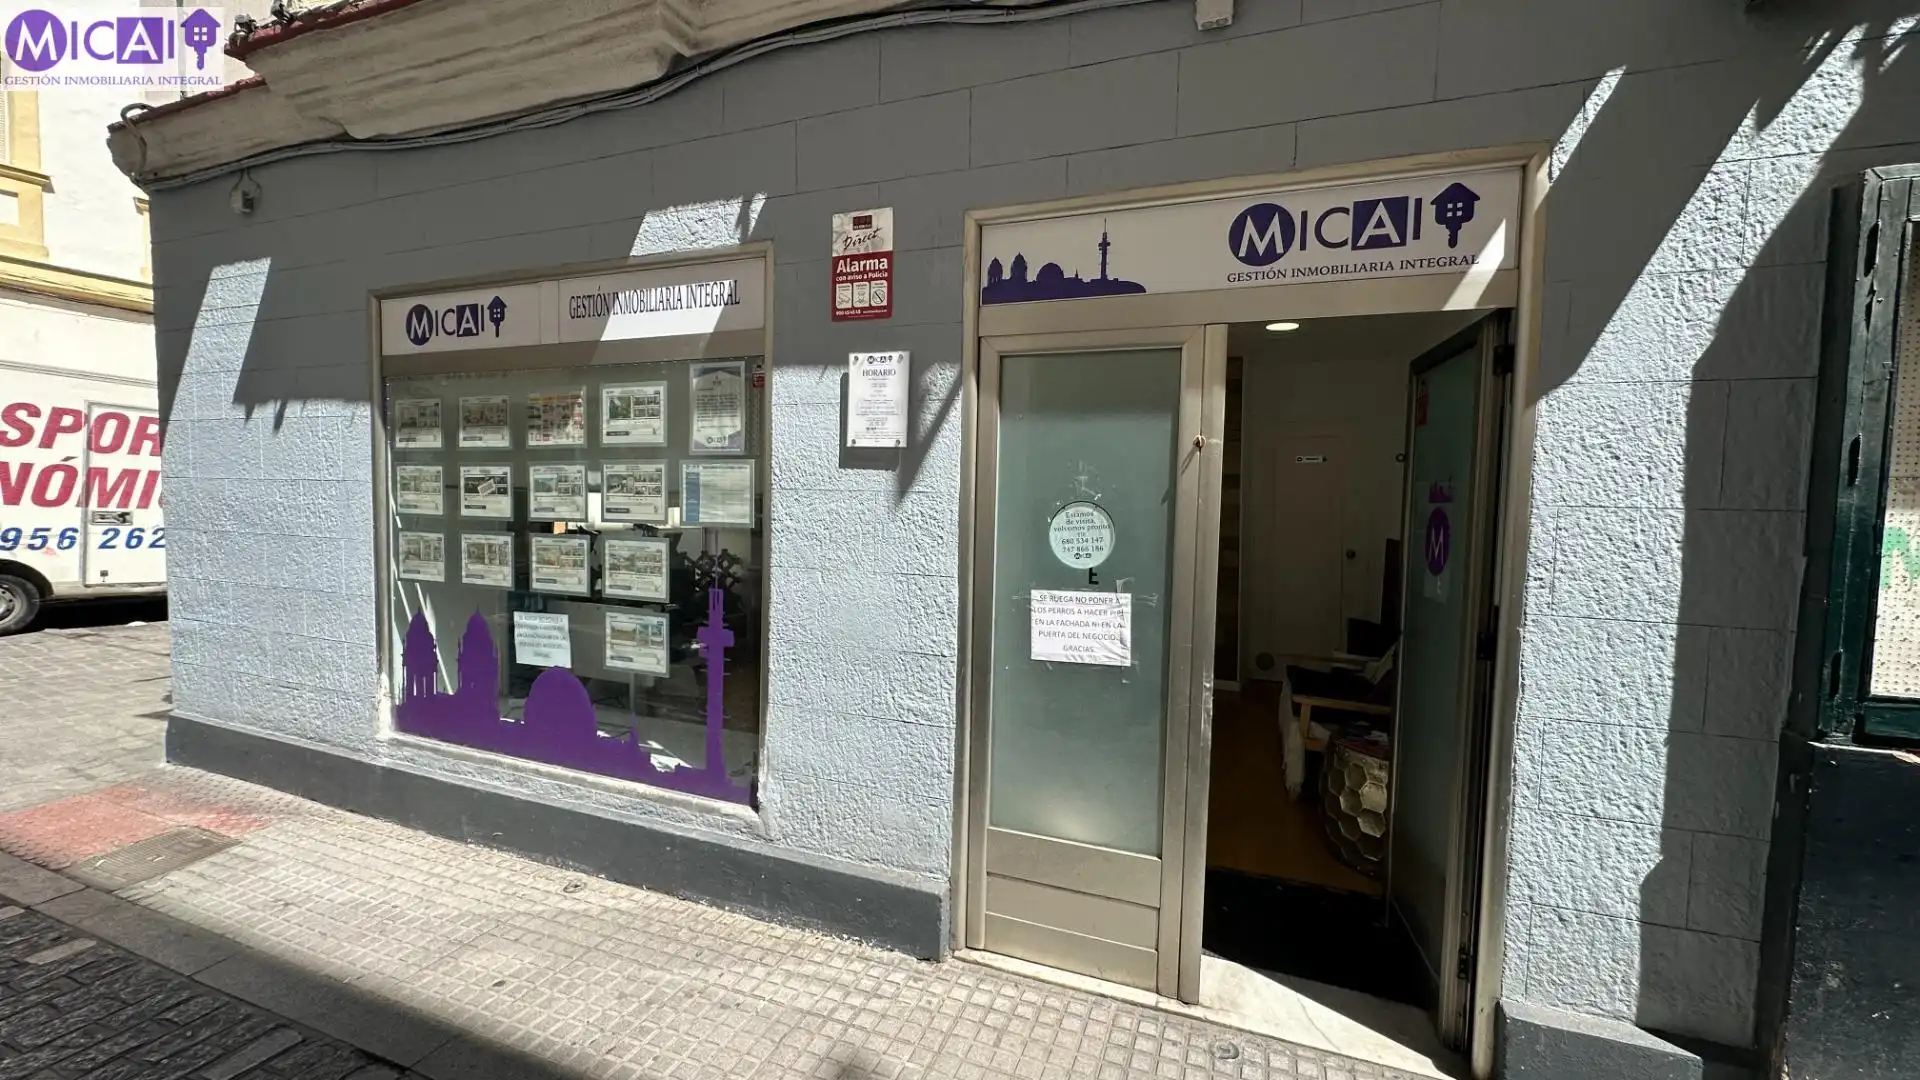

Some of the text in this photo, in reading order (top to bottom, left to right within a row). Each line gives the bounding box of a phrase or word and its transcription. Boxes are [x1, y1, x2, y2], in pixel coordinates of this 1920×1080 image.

[1228, 196, 1422, 266] MICAI
[836, 257, 888, 274] Alarma
[1227, 254, 1480, 283] GESTIÓN INMOBILIARIA INTEGRAL
[569, 280, 741, 320] GESTIÓN INMOBILIARIA INTEGRAL
[405, 303, 485, 346] MICAI
[862, 368, 896, 377] HORARIO
[0, 456, 164, 510] NÓMI
[0, 527, 165, 551] 956 262
[1039, 594, 1048, 602] SE
[1049, 595, 1074, 603] RUEGA
[1075, 596, 1087, 605] NO
[1088, 596, 1113, 605] PONER
[1048, 607, 1075, 616] PERROS
[1056, 619, 1090, 627] FACHADA
[1101, 621, 1111, 629] EN
[1038, 630, 1066, 638] PUERTA
[1067, 631, 1081, 639] DEL
